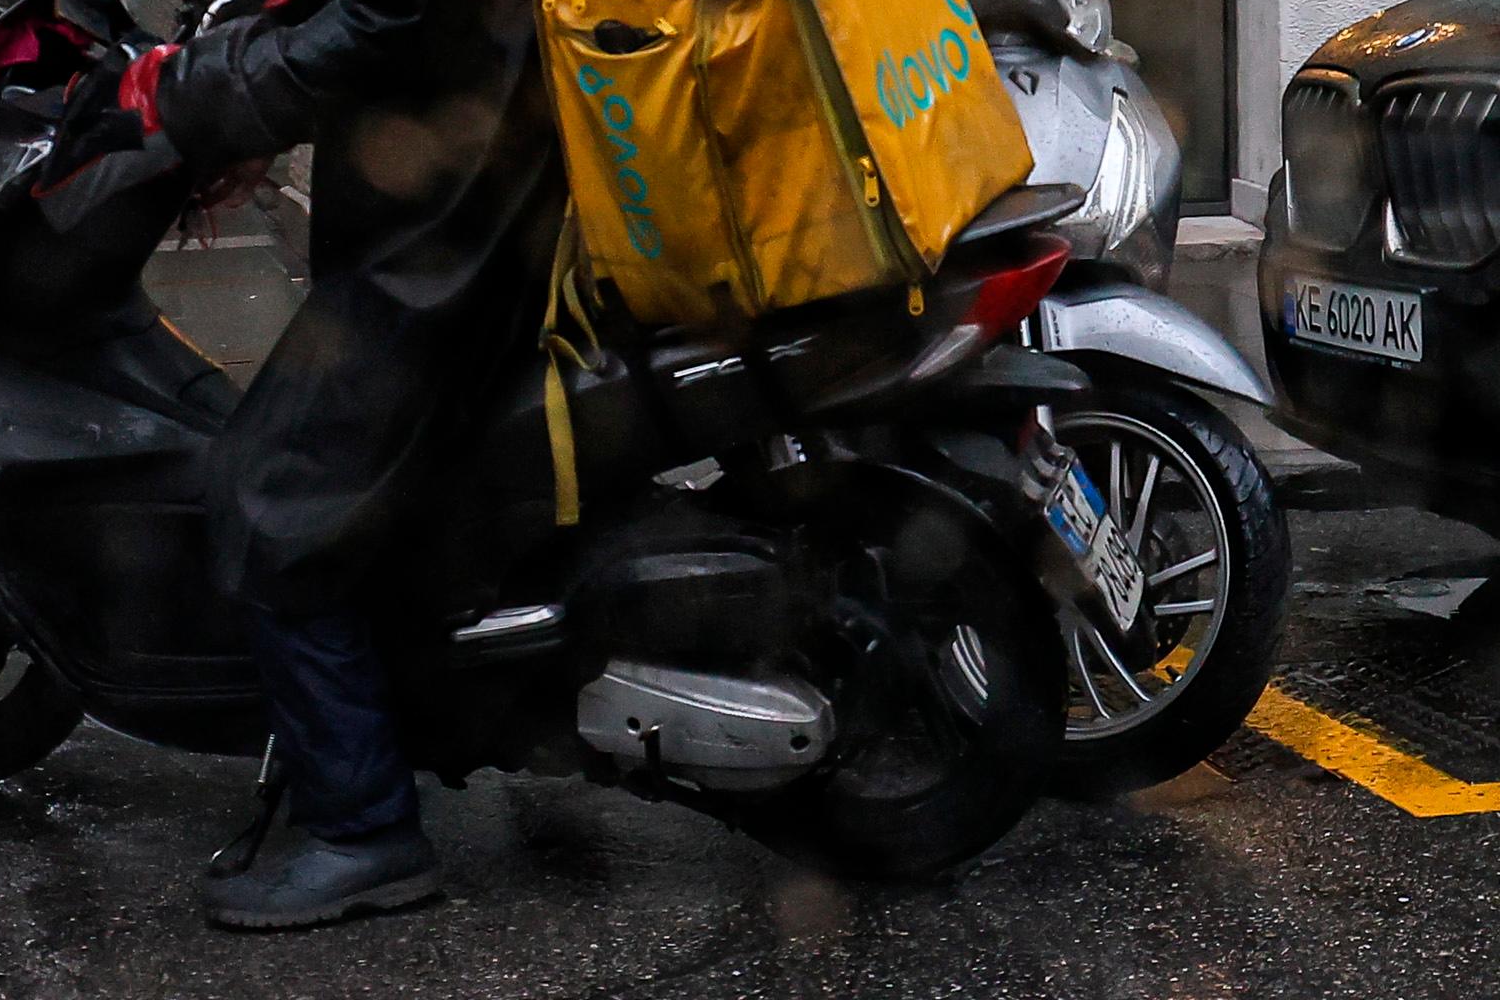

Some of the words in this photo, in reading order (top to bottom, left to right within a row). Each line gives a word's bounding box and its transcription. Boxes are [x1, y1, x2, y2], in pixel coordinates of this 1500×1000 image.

[1295, 284, 1323, 333] KE
[1327, 290, 1376, 344] 6020
[1383, 301, 1418, 352] AK
